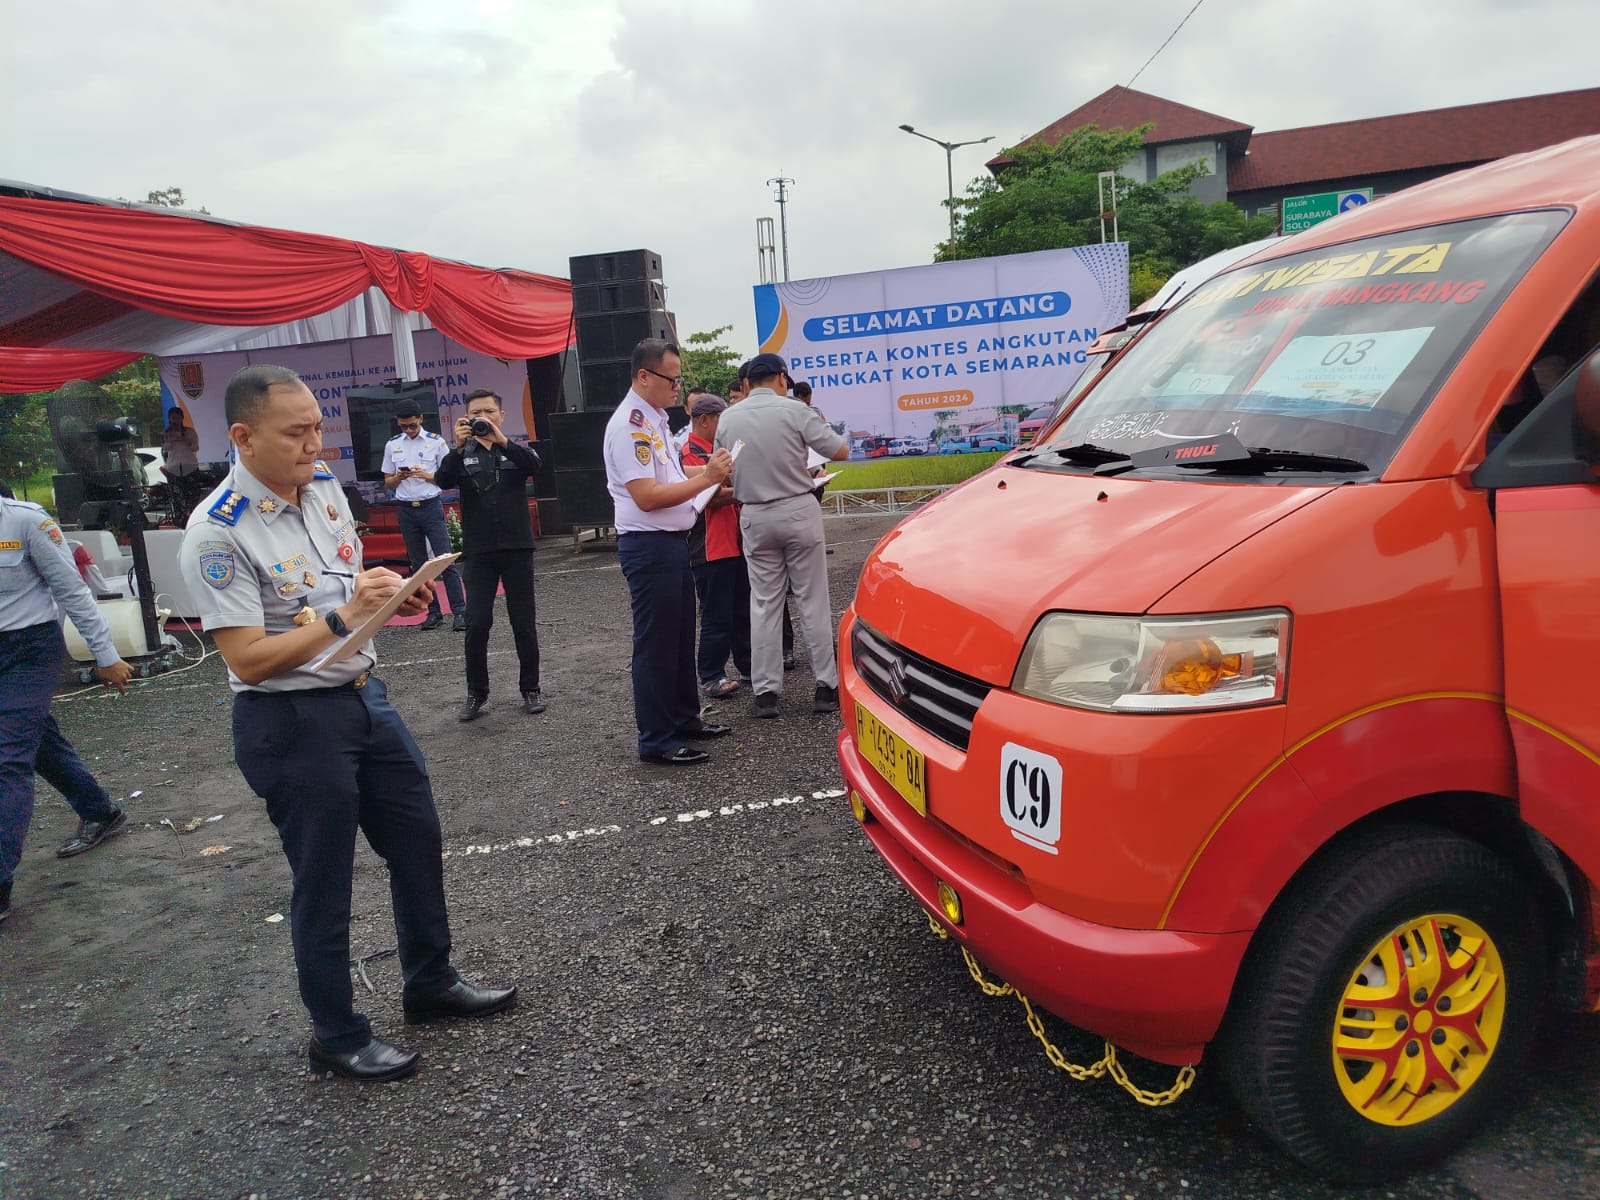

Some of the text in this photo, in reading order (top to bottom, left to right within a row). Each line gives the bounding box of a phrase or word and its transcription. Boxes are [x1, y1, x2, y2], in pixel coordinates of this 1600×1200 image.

[1286, 209, 1332, 221] SURABAYA
[1287, 200, 1307, 208] JALUR
[1286, 221, 1310, 230] SOLO
[1262, 242, 1452, 291] WISATA
[1316, 280, 1487, 309] MANGKANG
[822, 295, 1055, 336] SELAMAT DATANG
[790, 327, 1098, 370] PESERTA KONTES ANGKUTAN
[1320, 338, 1376, 366] 03
[326, 369, 365, 379] KEMBALI
[368, 366, 379, 375] KE
[438, 357, 468, 368] UMUM
[808, 349, 1088, 389] TINGKAT KOTA SEMARANG
[902, 393, 969, 407] TAHUN 2024
[1174, 444, 1220, 460] THULE
[856, 705, 864, 739] H
[1006, 759, 1051, 829] C9
